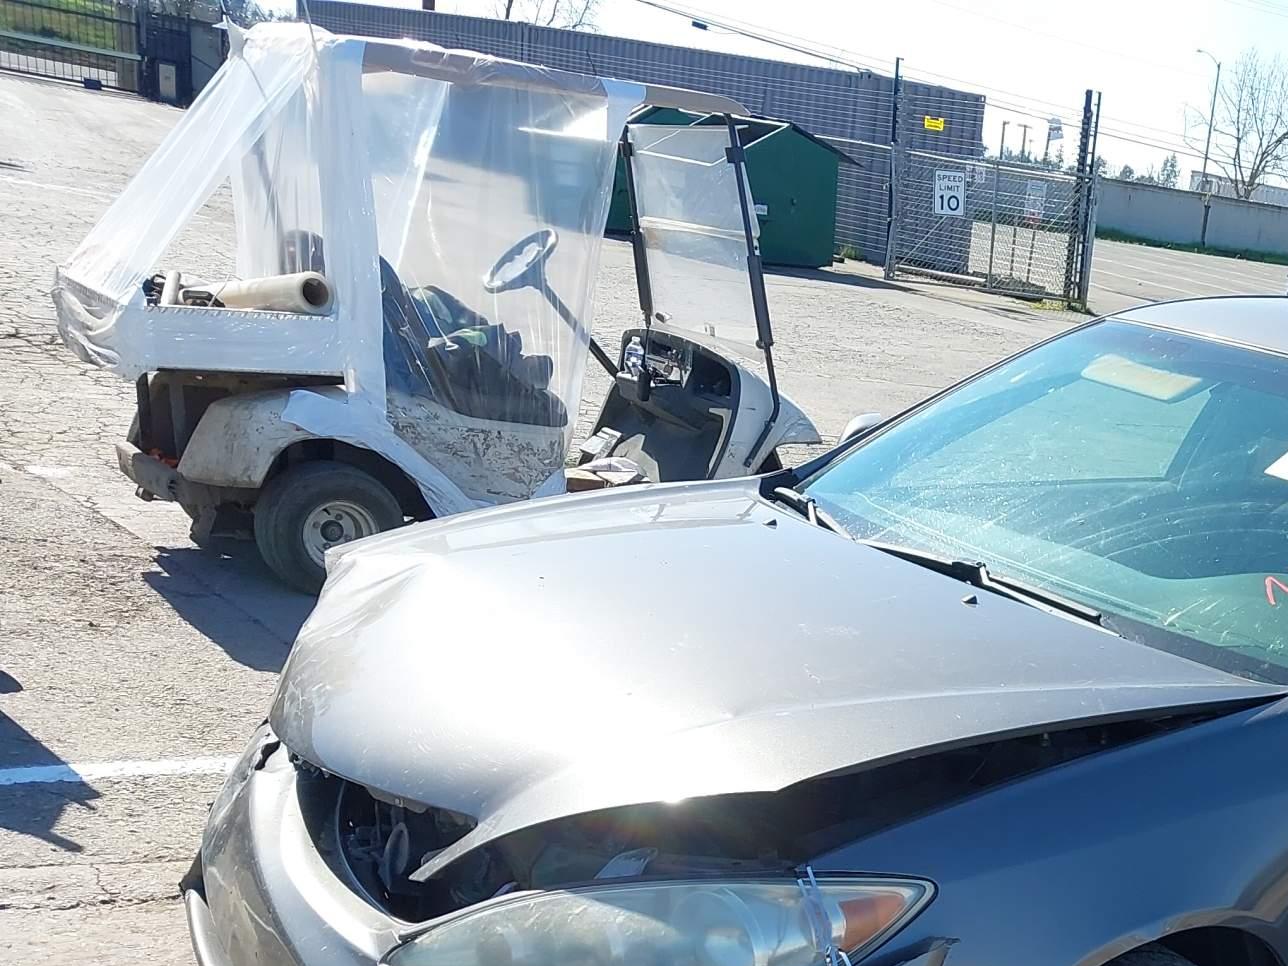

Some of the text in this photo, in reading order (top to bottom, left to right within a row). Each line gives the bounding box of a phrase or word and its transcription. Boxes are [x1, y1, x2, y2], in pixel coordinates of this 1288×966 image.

[937, 174, 963, 183] SPEED
[939, 184, 960, 192] LIMIT
[939, 194, 960, 211] 10
